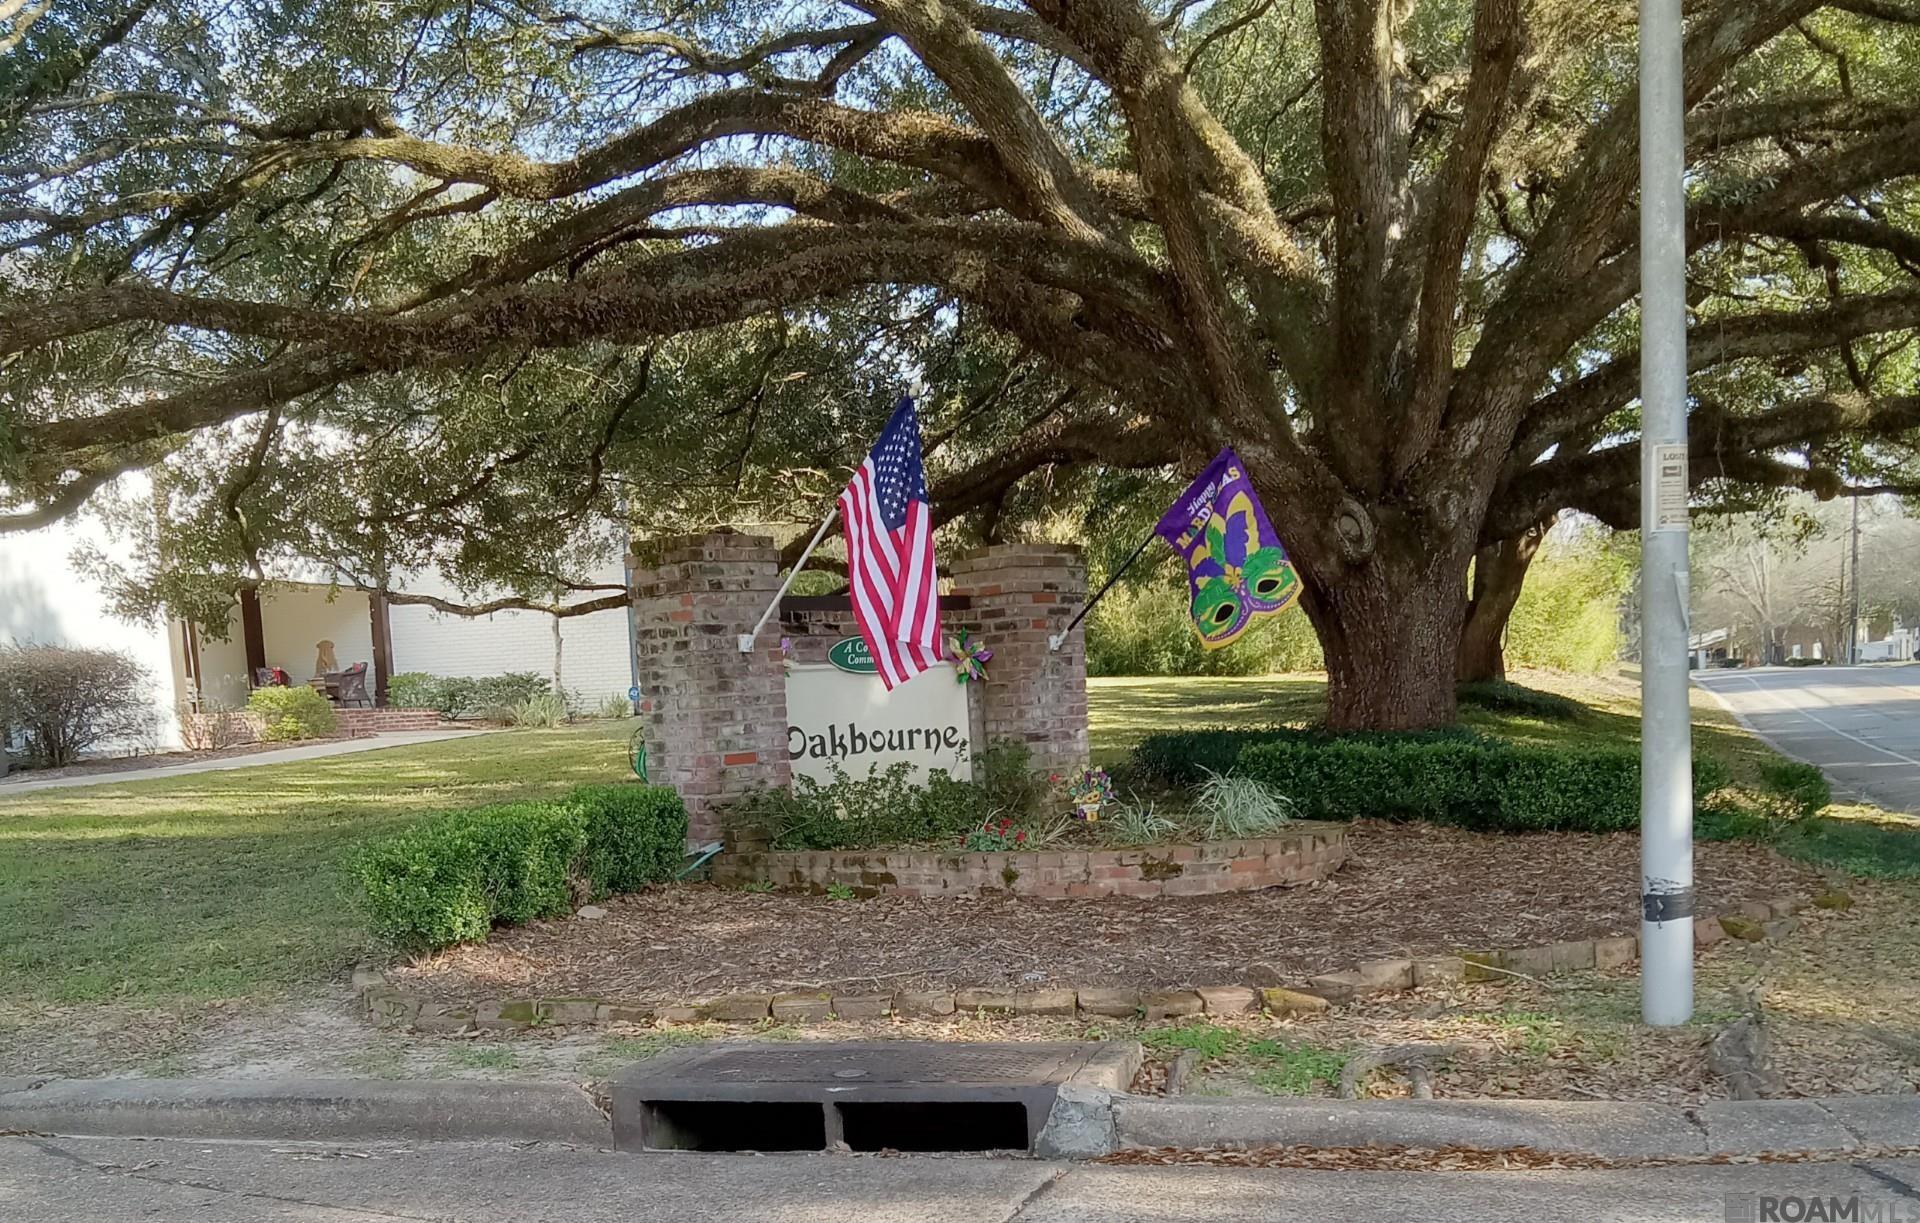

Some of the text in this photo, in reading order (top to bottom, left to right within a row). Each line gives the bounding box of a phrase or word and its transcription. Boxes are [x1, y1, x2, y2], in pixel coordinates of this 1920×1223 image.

[1187, 481, 1216, 516] Happy
[843, 641, 852, 654] A
[787, 722, 960, 761] Oakbourne
